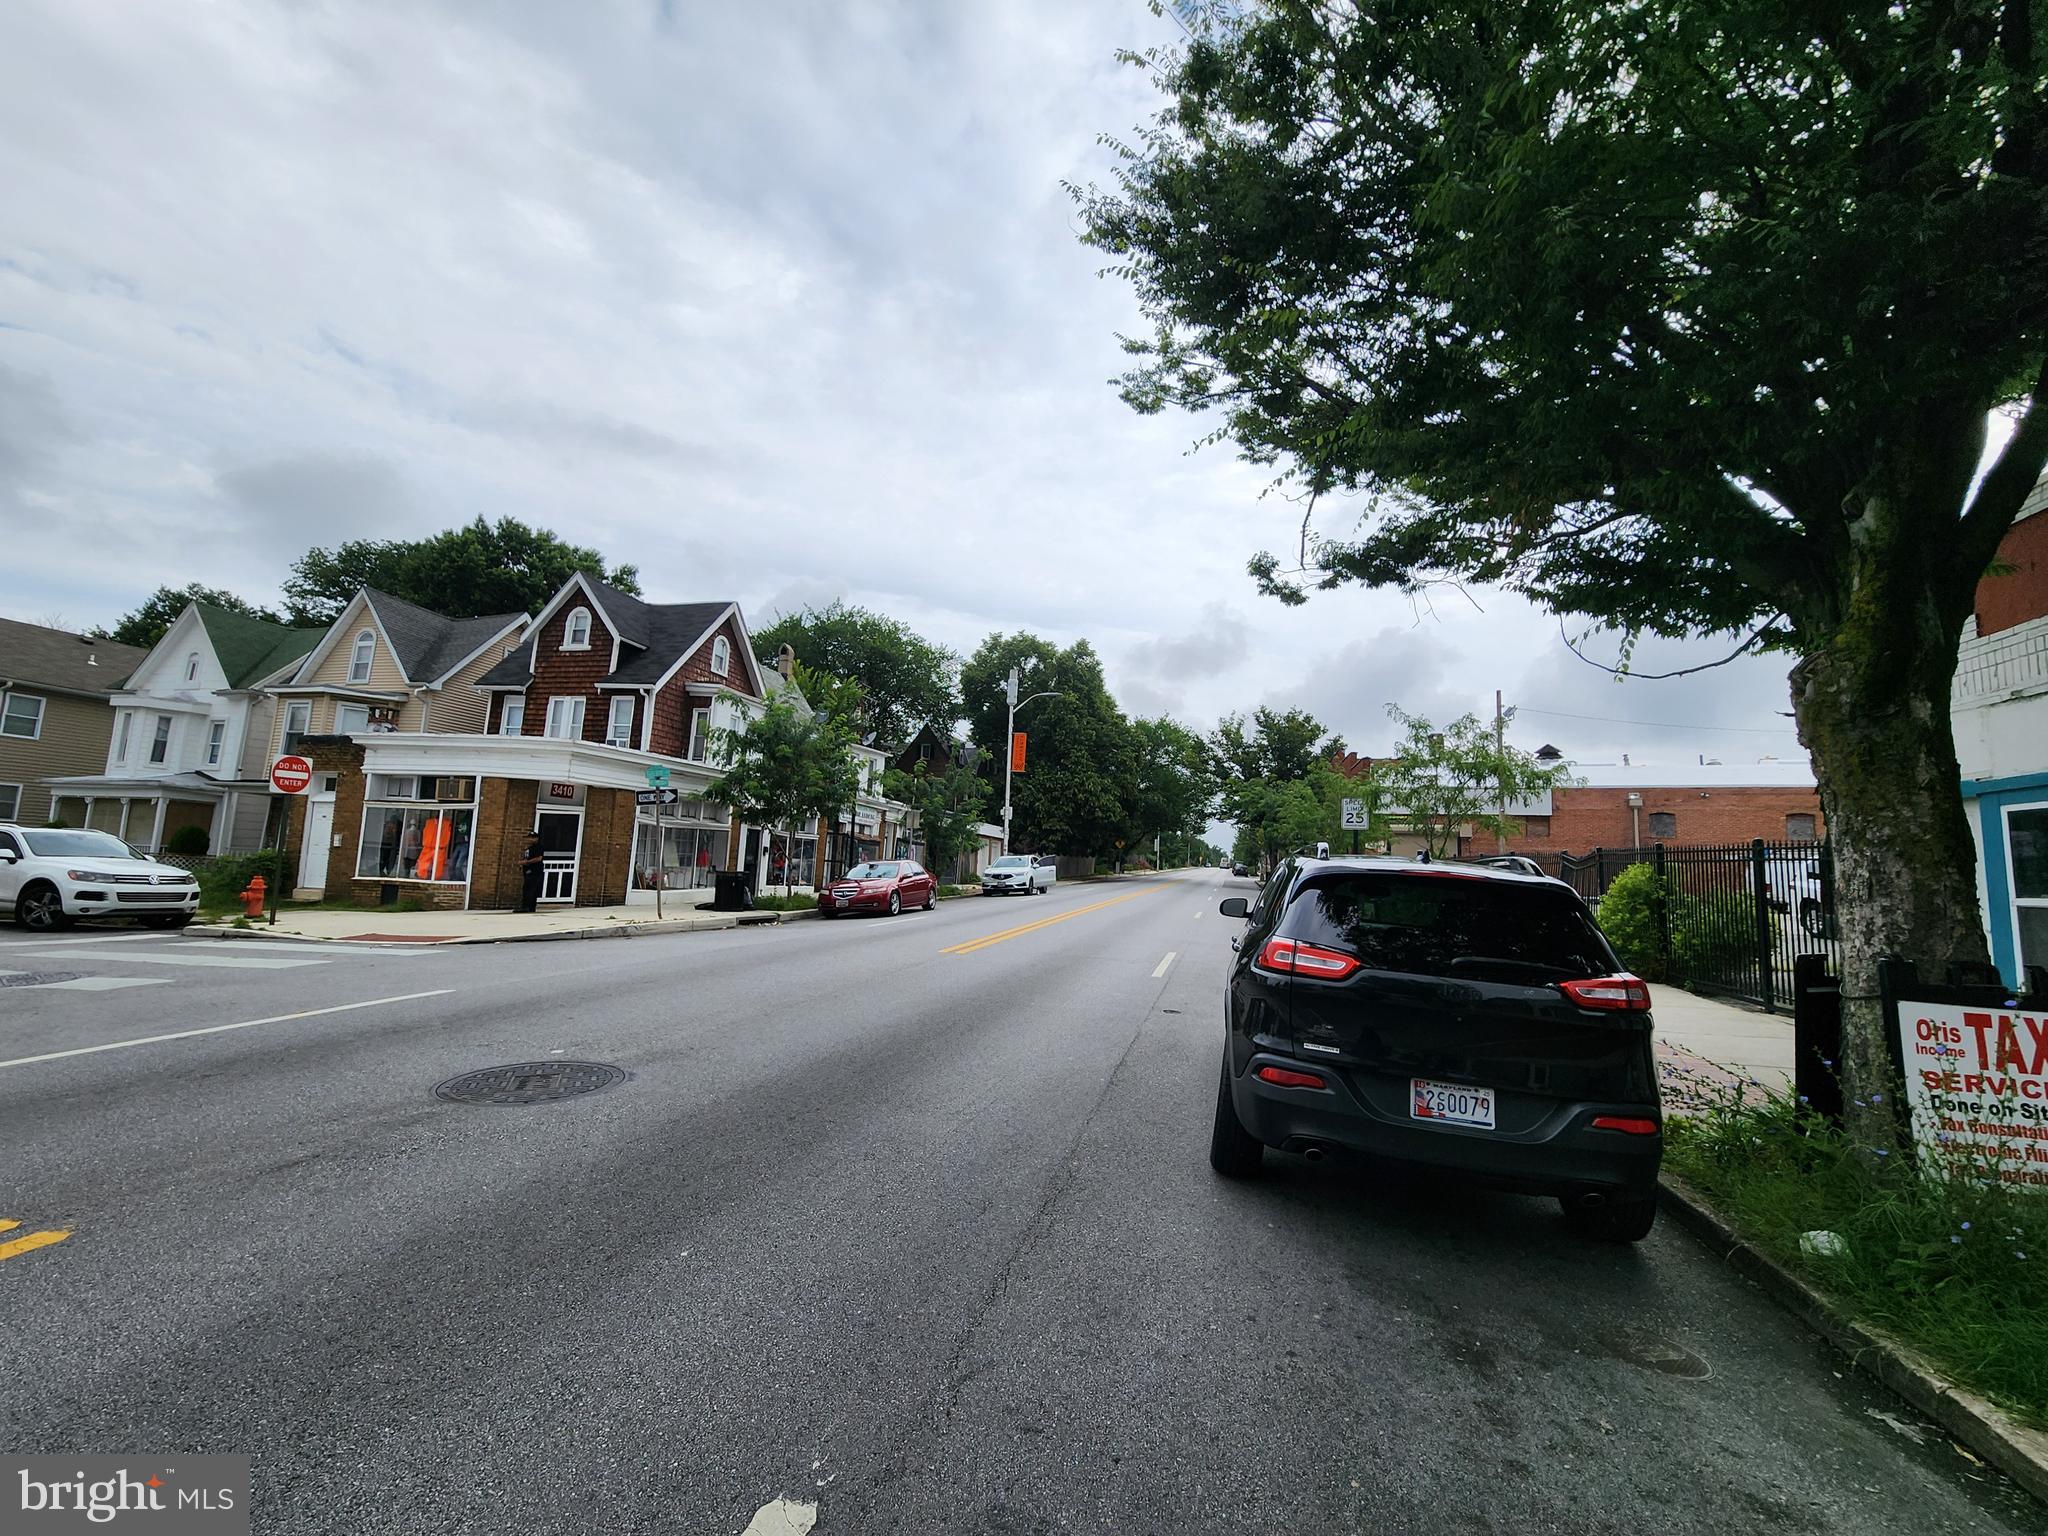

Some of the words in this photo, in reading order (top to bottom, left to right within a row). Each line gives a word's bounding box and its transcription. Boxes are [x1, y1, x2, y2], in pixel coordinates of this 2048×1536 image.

[280, 779, 302, 787] ENTER
[552, 785, 573, 796] 3410
[1345, 812, 1364, 824] 25
[1433, 1083, 1472, 1093] MARYLAND
[1923, 1070, 2048, 1101] SERVIC
[1988, 1103, 2014, 1118] on
